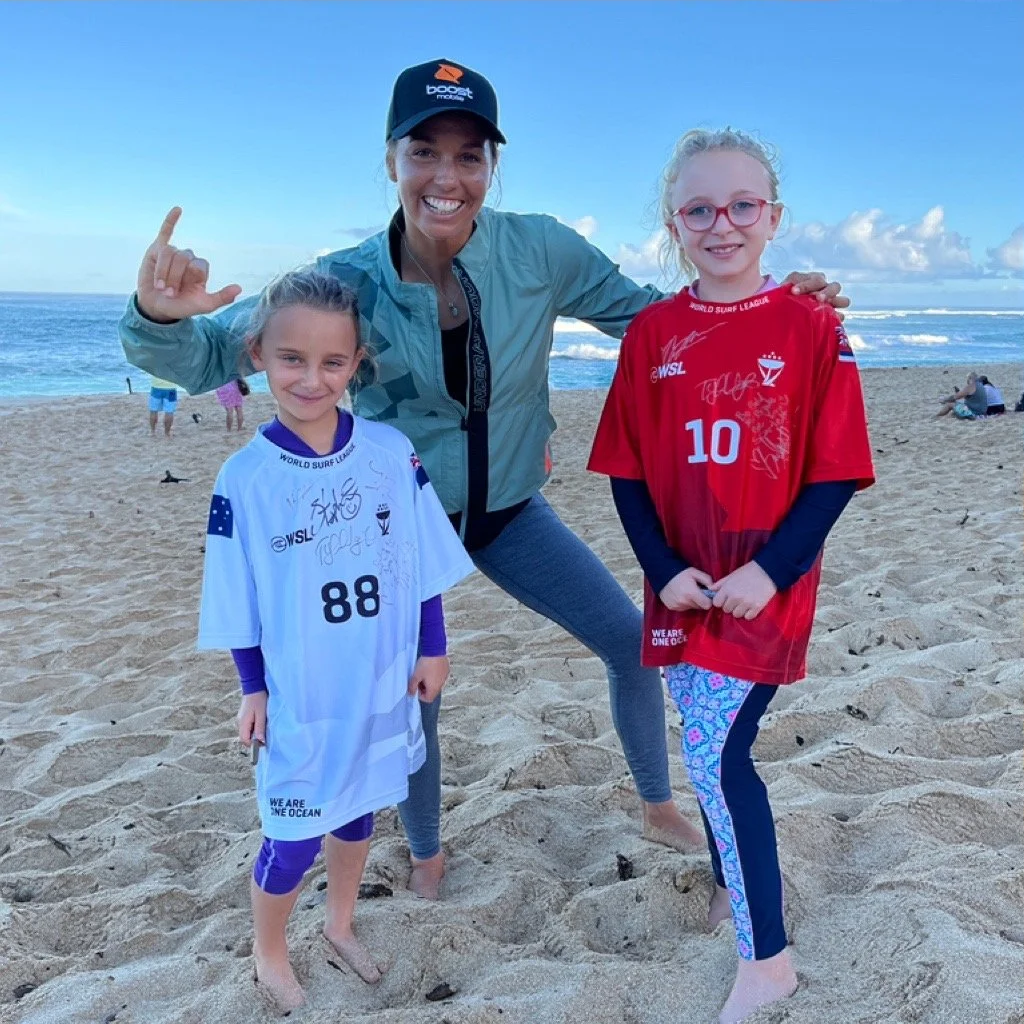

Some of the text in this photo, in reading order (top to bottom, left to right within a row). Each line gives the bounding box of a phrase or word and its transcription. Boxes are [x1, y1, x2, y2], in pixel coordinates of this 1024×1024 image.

[426, 84, 474, 100] boost
[689, 295, 770, 314] WORLD SURF LEAGUE
[658, 361, 686, 379] WSL
[685, 418, 741, 464] 10
[279, 452, 310, 469] WORLD
[312, 459, 335, 469] SURF
[286, 528, 313, 547] WSL
[321, 574, 380, 624] 88
[651, 628, 684, 637] WE ARE
[651, 637, 670, 646] ONE
[270, 797, 306, 808] WE ARE
[288, 808, 322, 818] OCEAN
